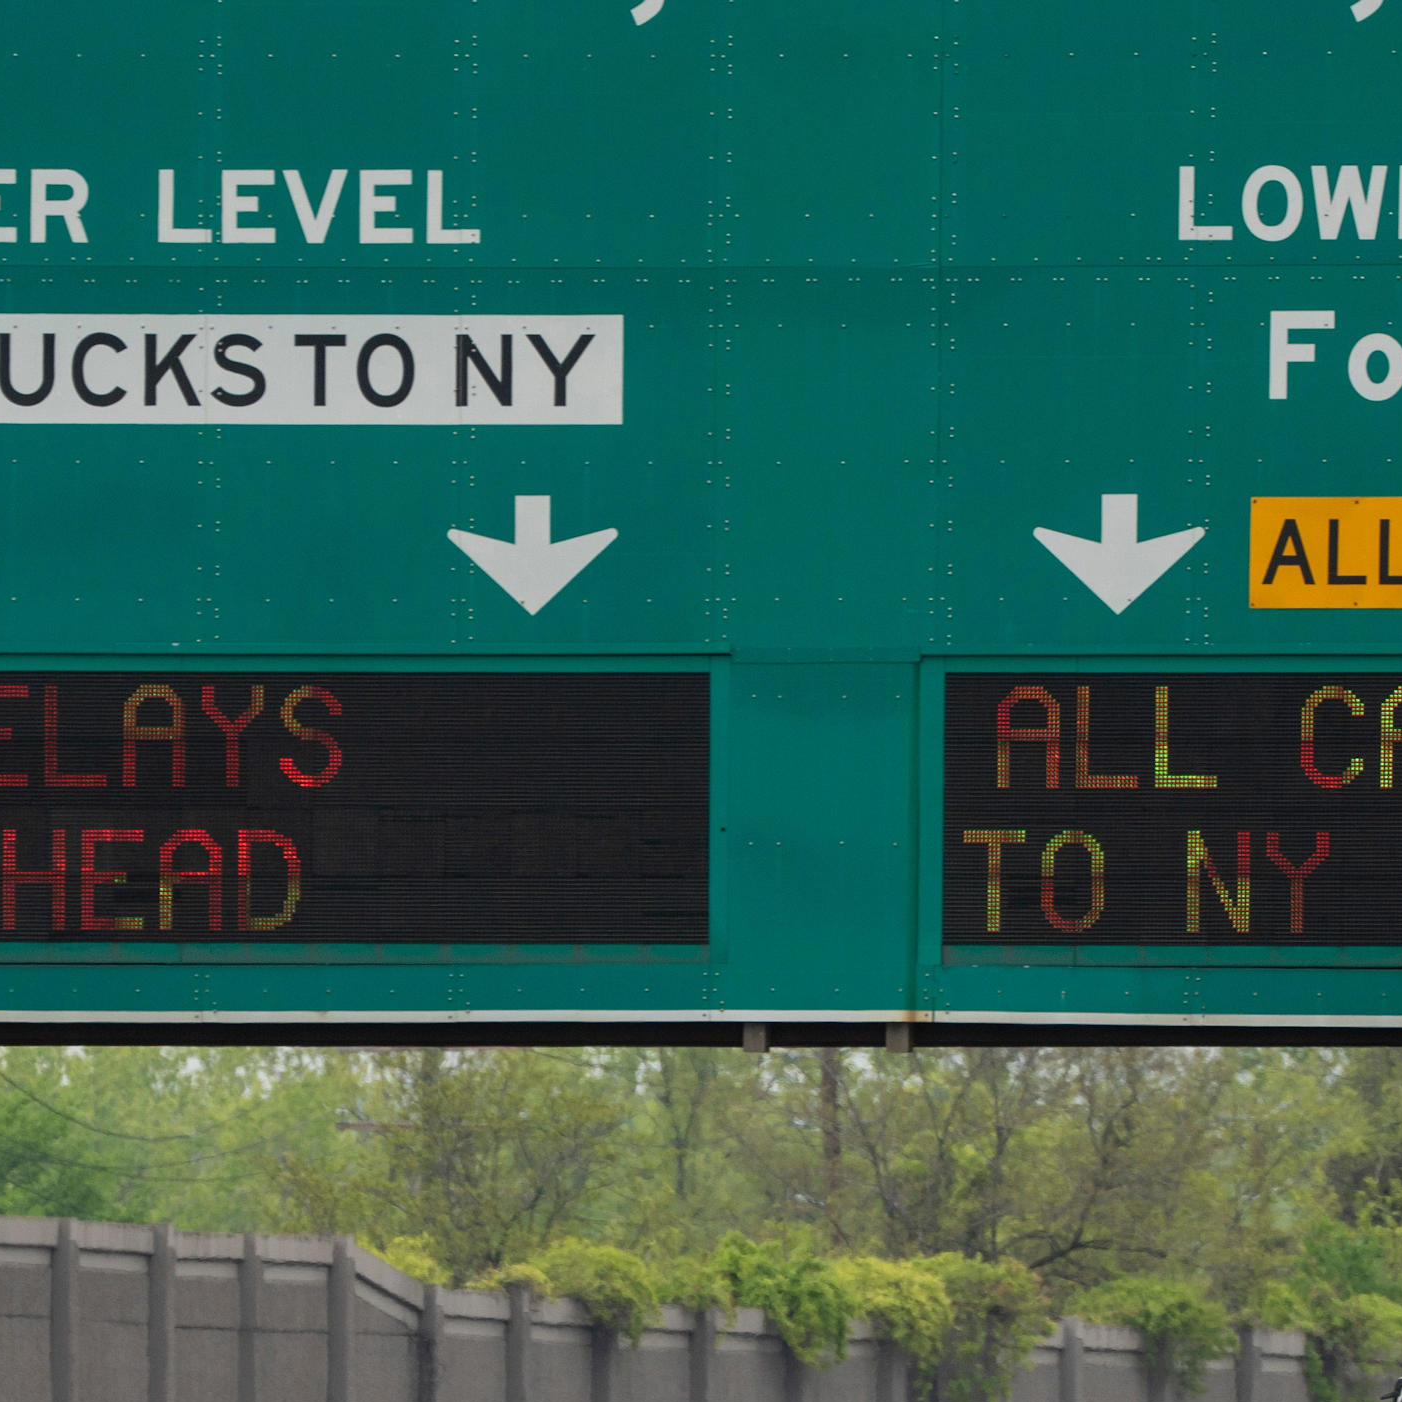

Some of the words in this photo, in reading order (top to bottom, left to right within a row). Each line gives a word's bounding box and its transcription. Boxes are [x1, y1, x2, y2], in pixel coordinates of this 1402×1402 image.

[158, 169, 481, 244] LEVEL
[294, 334, 415, 408] TO
[456, 335, 595, 408] NY
[998, 684, 1218, 789] ALL
[962, 829, 1105, 933] TO
[1186, 829, 1331, 934] NY
